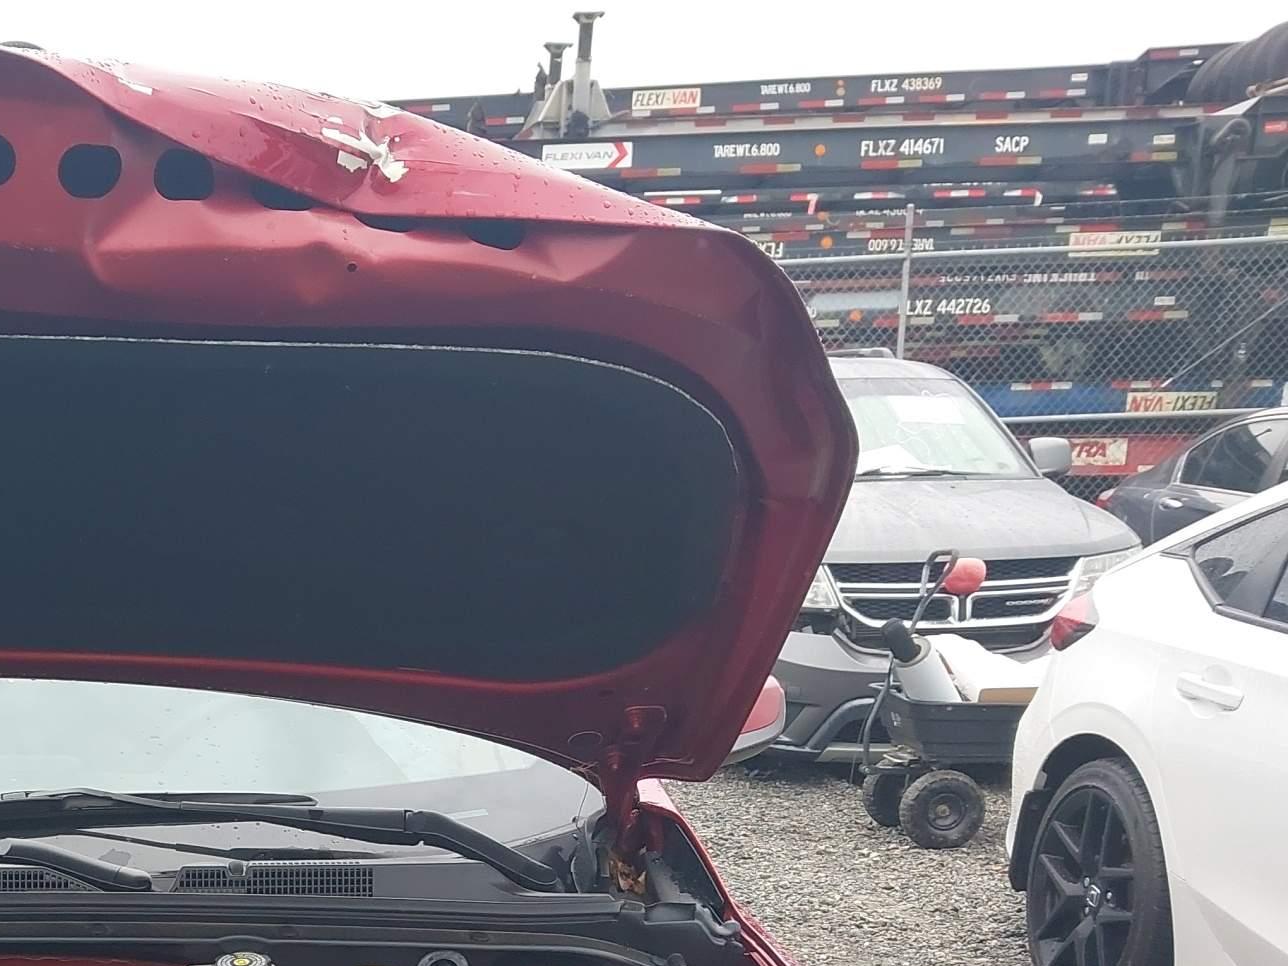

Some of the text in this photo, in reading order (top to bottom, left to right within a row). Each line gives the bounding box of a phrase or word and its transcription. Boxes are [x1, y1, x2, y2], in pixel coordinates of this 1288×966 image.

[871, 76, 943, 92] FLXZ 438369
[860, 138, 945, 156] FLXZ 414671
[994, 136, 1029, 153] SACP
[898, 298, 991, 315] LXZ 442726
